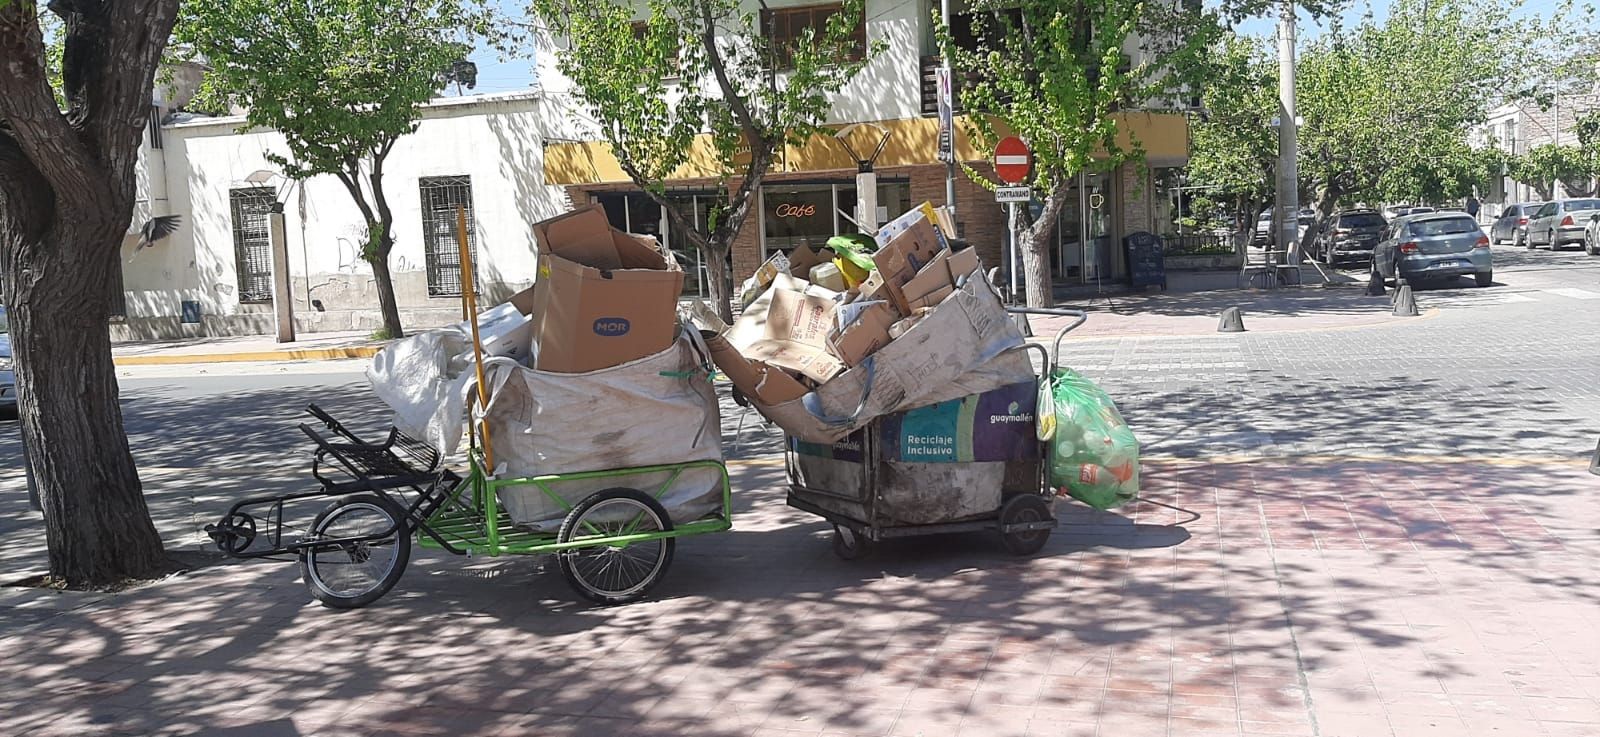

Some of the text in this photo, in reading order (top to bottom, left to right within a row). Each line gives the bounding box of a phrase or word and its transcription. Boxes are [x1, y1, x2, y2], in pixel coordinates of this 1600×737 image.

[775, 203, 816, 218] Café
[597, 322, 626, 332] MOR
[990, 412, 1033, 424] guaymallén
[907, 434, 953, 446] Reciclaje
[907, 446, 953, 455] Inclusivo
